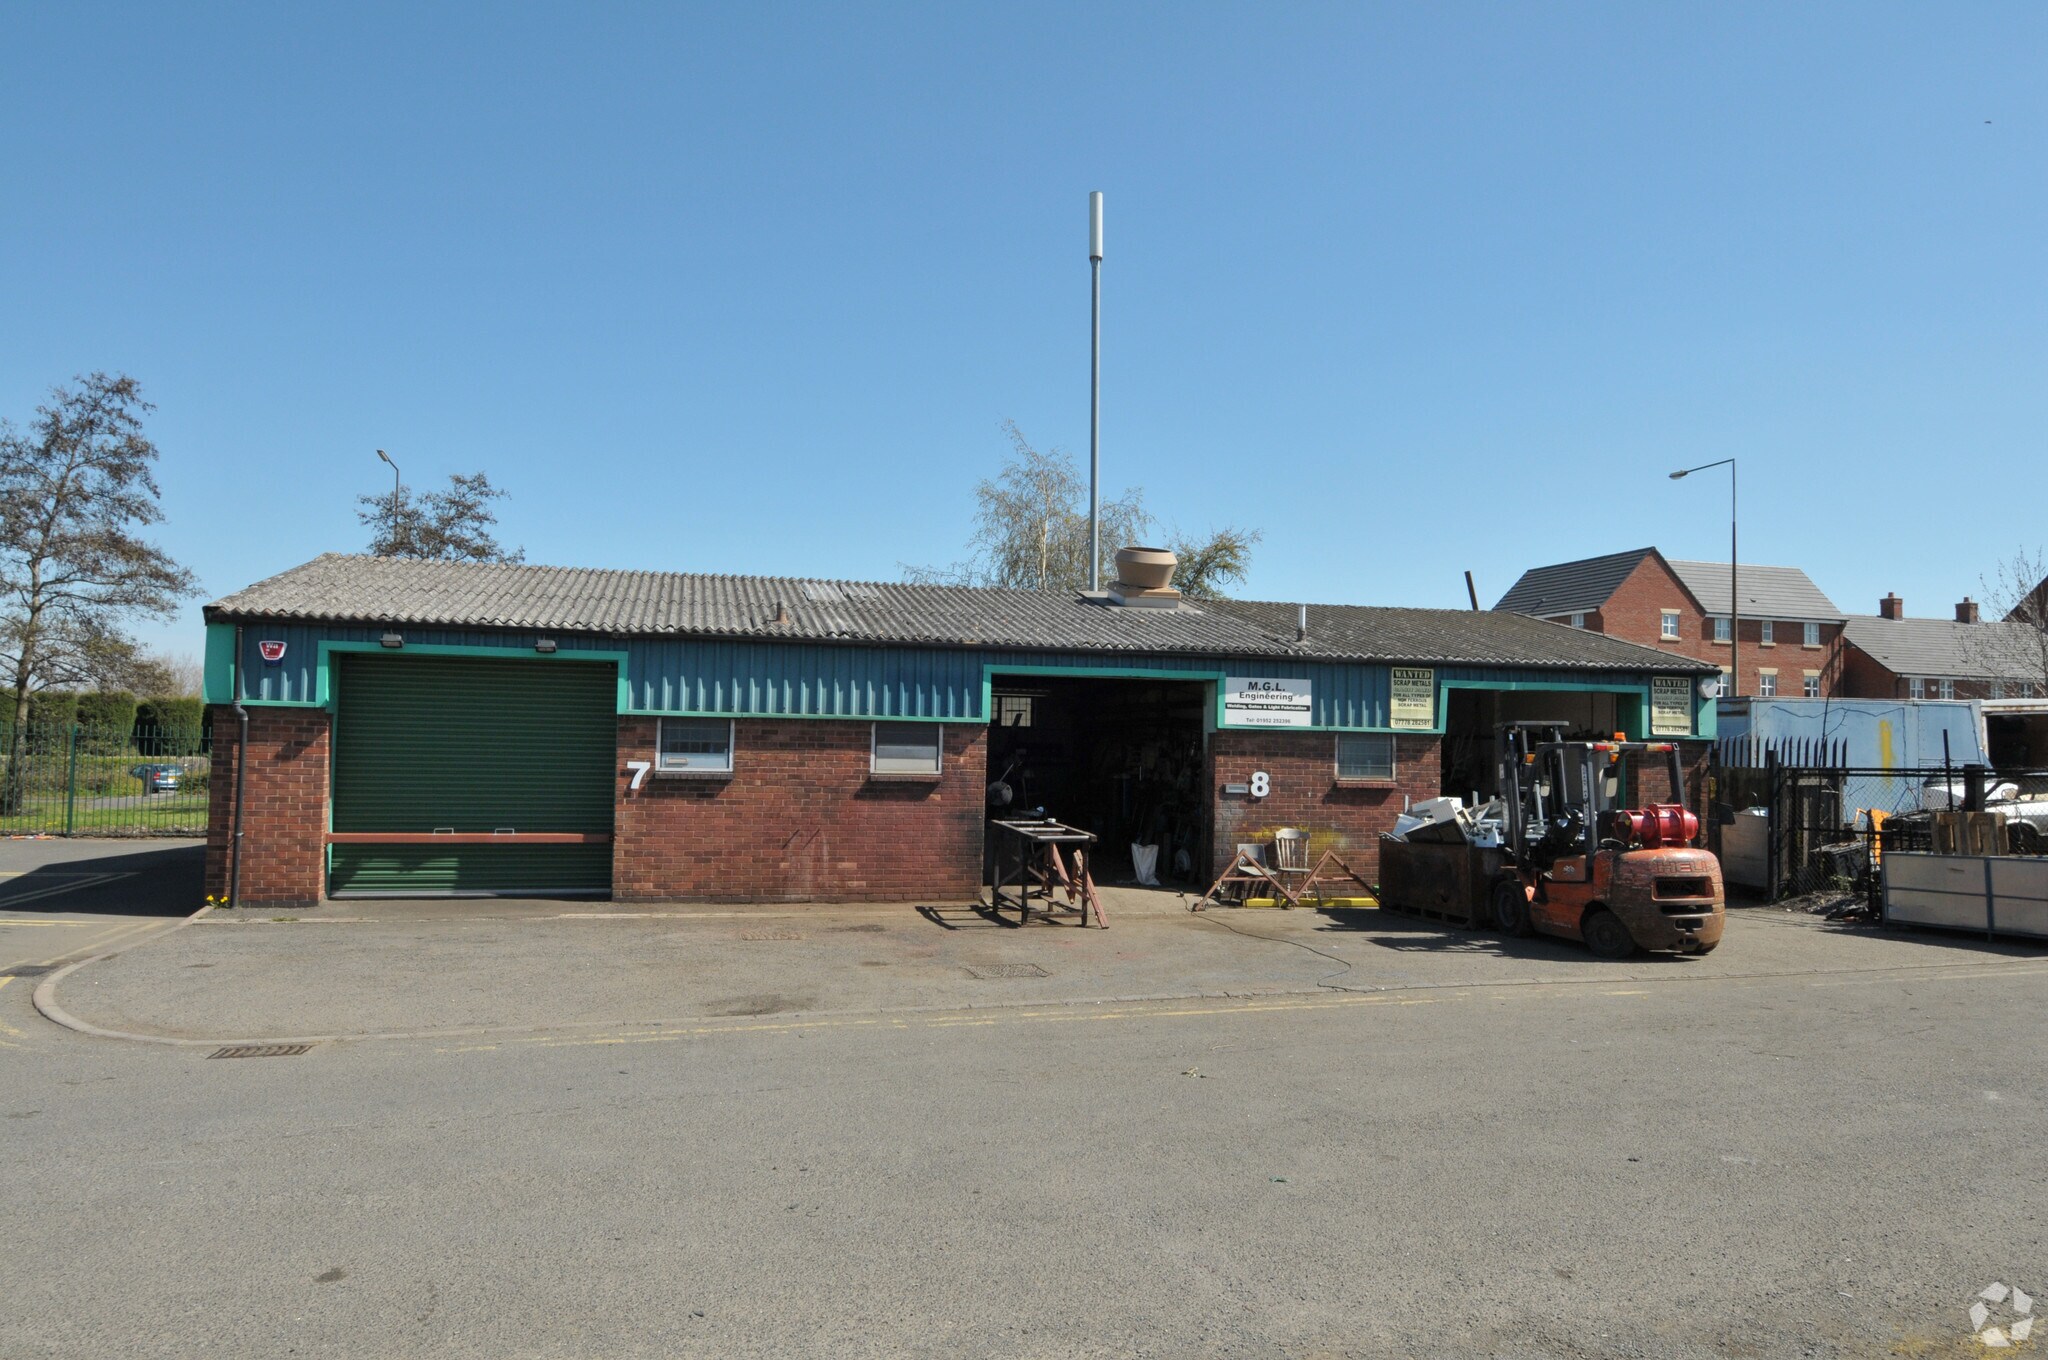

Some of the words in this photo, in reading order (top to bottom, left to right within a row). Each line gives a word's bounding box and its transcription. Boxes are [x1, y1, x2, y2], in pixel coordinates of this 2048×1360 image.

[1394, 670, 1430, 678] WANTED
[1248, 682, 1286, 692] M.G.L.
[1239, 692, 1293, 702] Engineering
[627, 762, 650, 789] 7
[1251, 772, 1269, 796] 8
[1656, 861, 1708, 874] HELI
